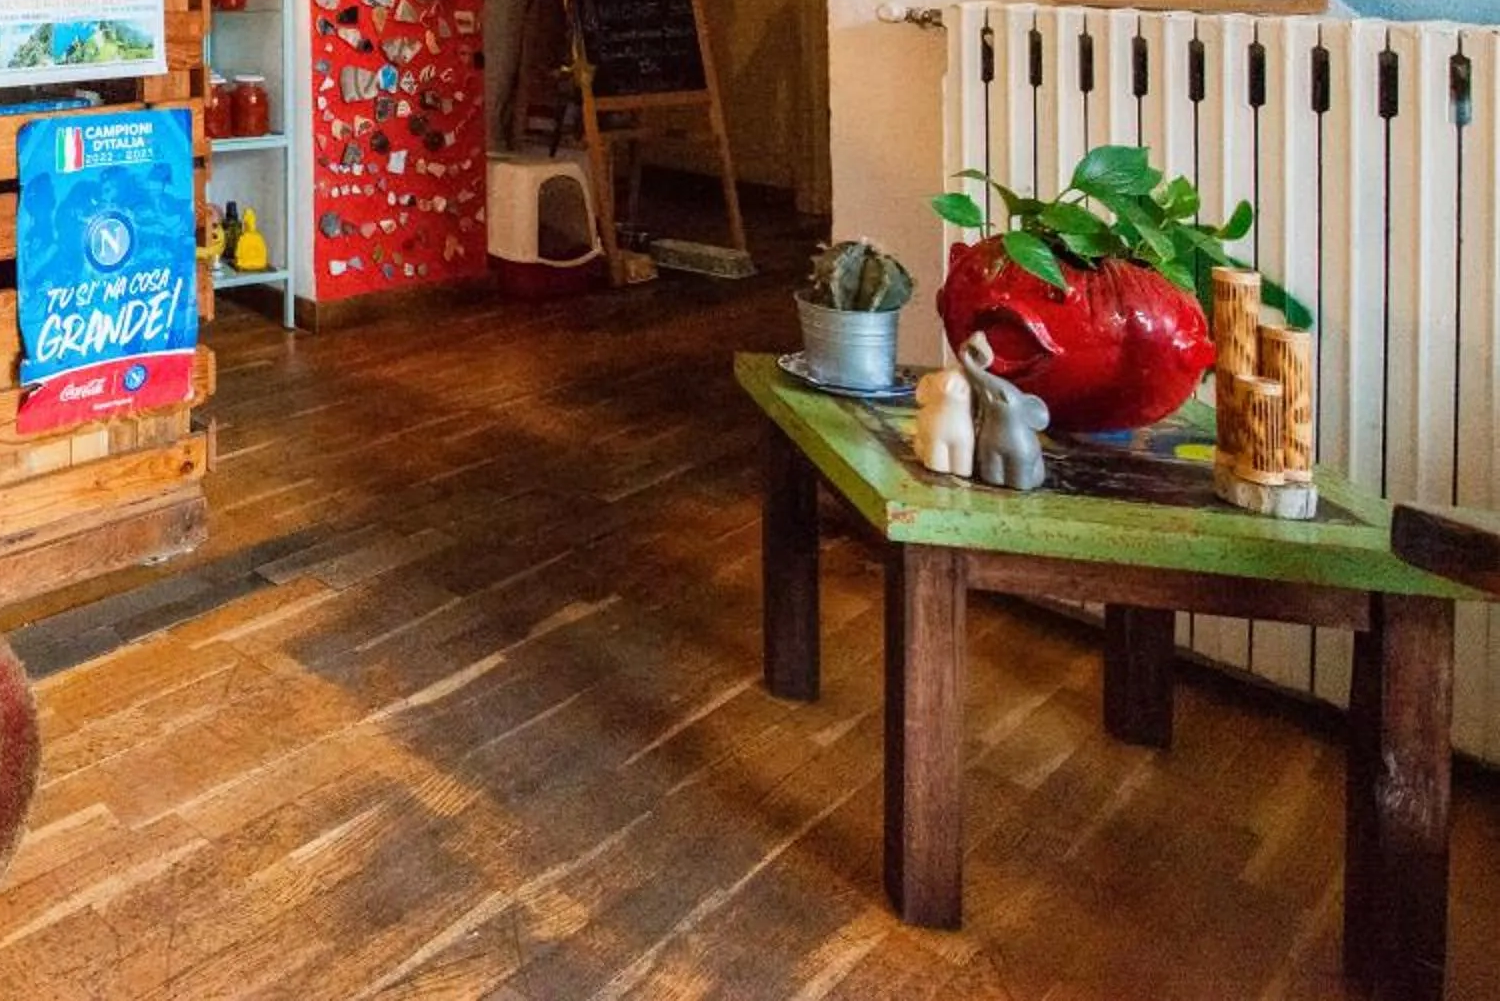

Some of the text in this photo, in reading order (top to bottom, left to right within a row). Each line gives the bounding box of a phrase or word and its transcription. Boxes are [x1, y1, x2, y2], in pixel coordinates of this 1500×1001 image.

[85, 123, 153, 140] CAMPIONI
[93, 136, 145, 151] D'ITALIA
[100, 227, 121, 255] N
[48, 287, 75, 314] TU
[130, 268, 171, 291] COSA
[37, 278, 182, 363] GRANDE!
